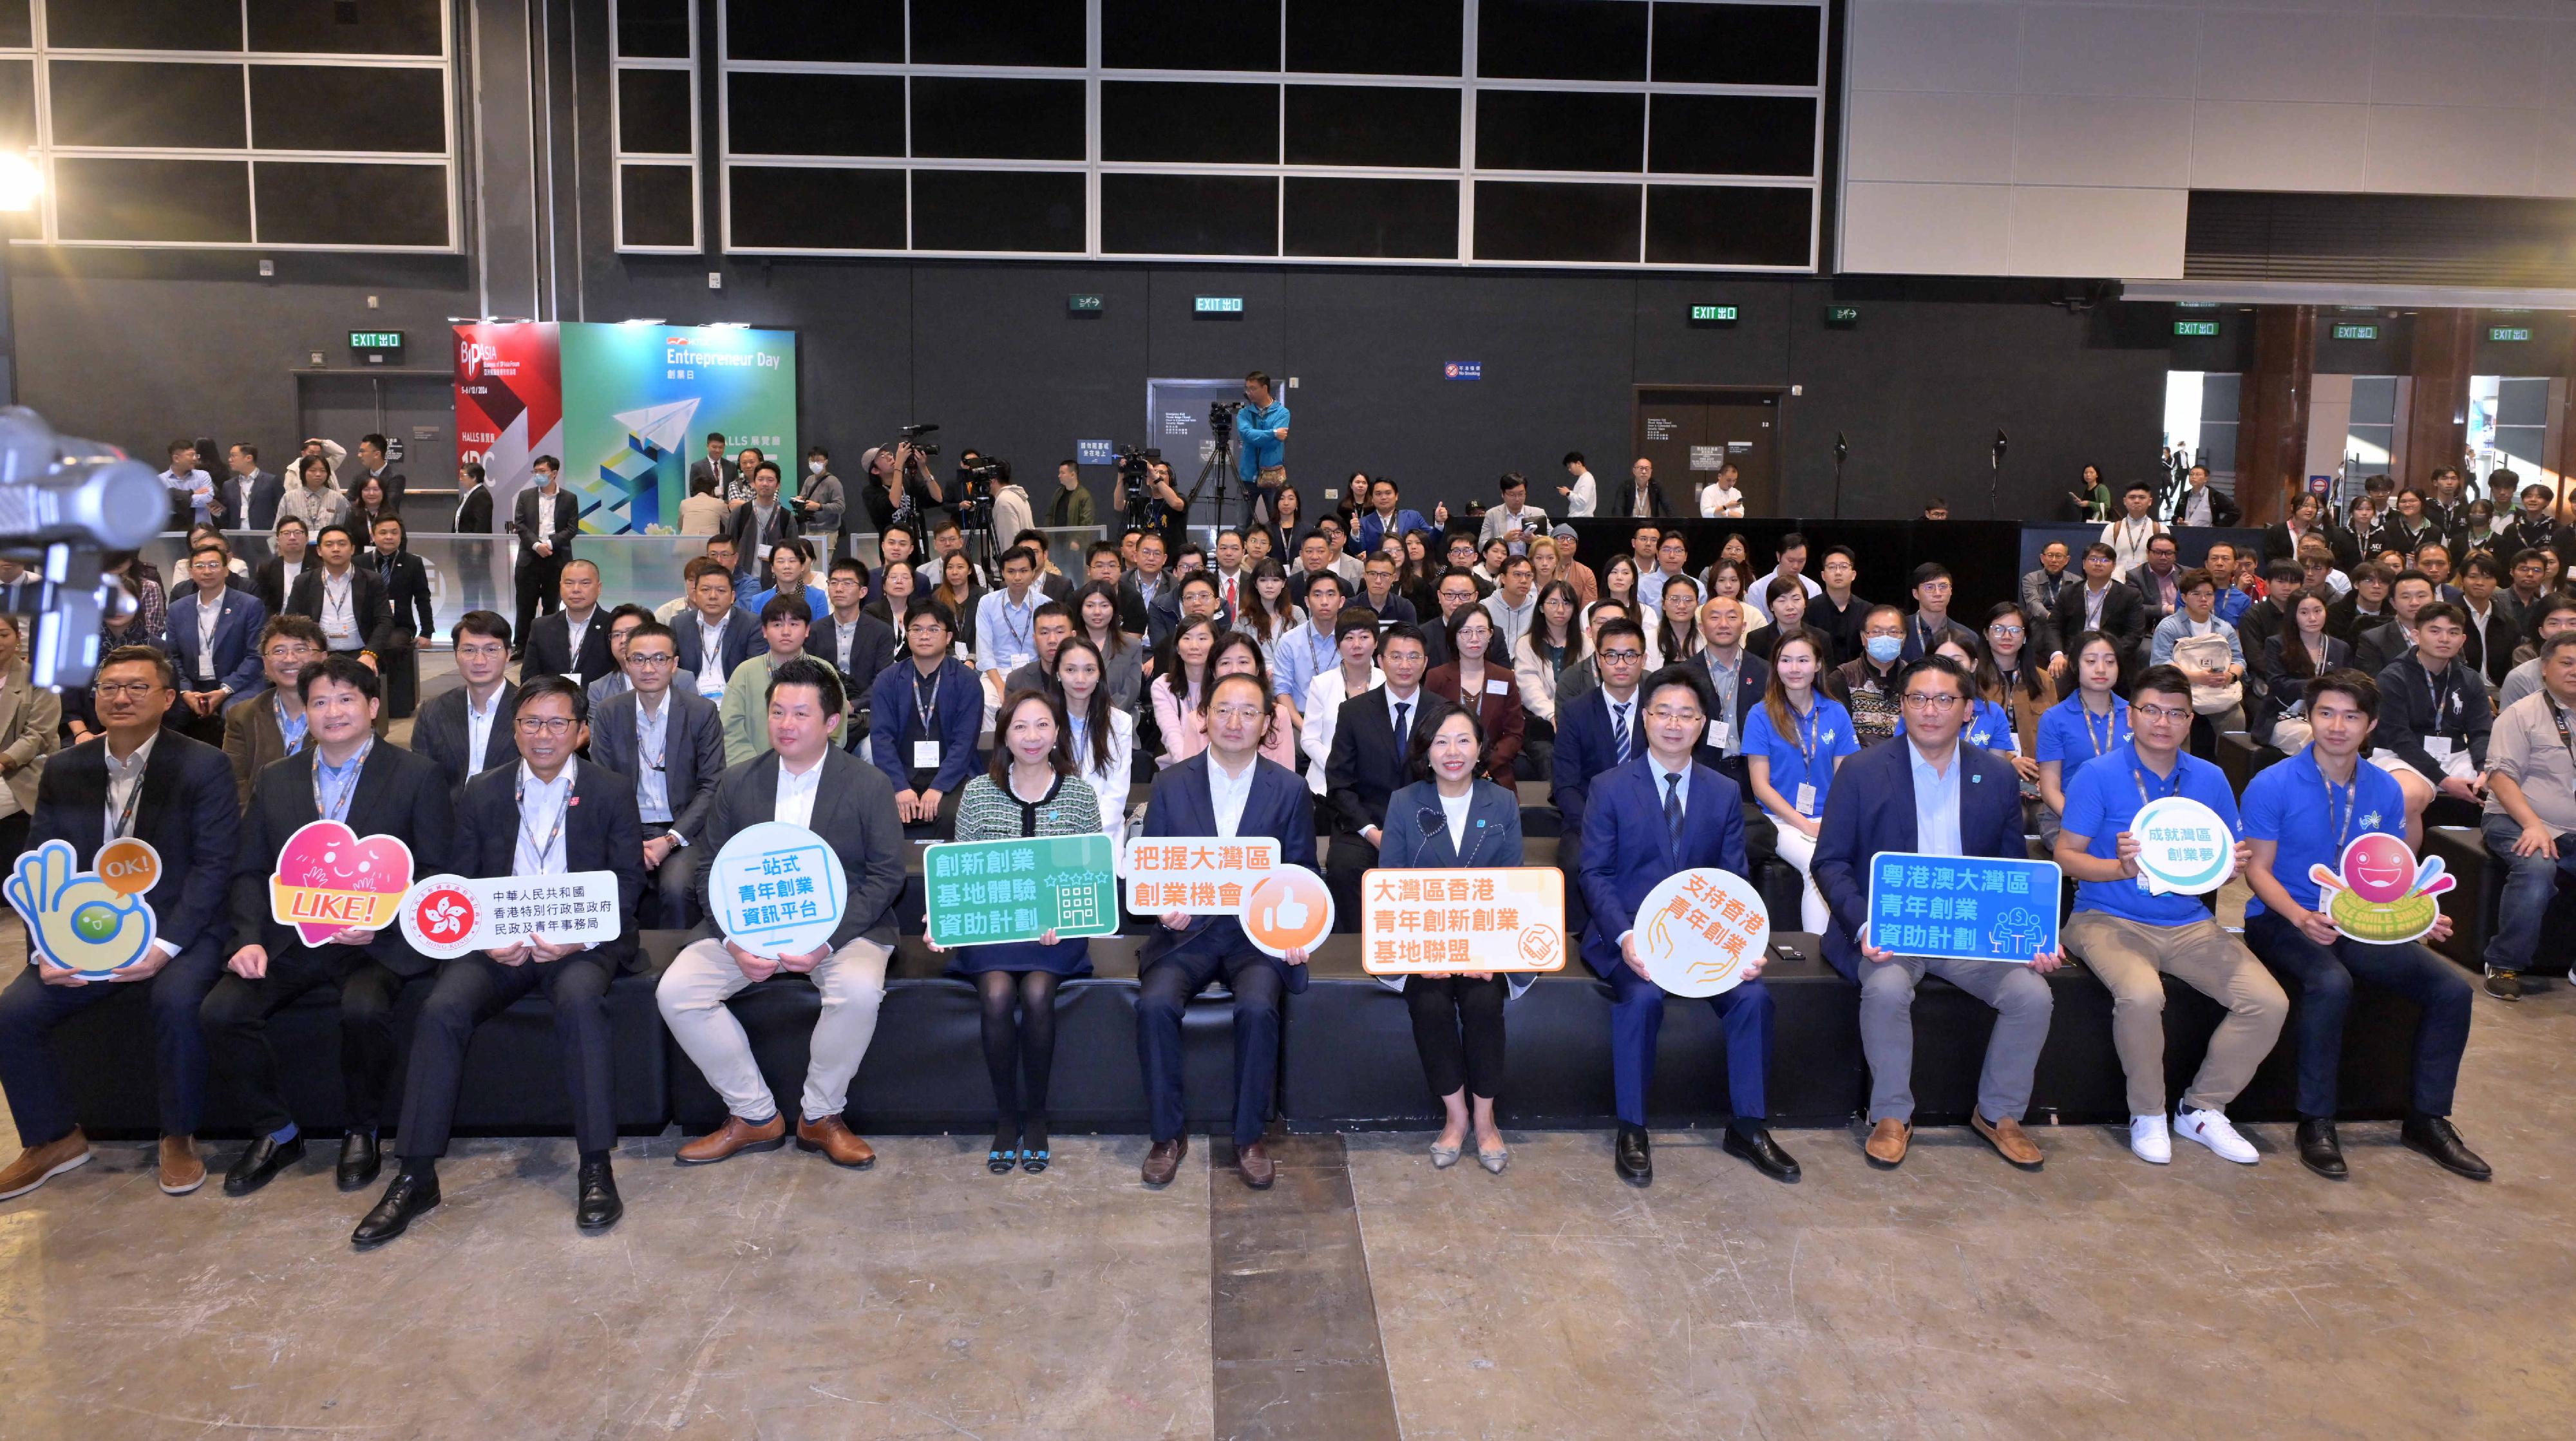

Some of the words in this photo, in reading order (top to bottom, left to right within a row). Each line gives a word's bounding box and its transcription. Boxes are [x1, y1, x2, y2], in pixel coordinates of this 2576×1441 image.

[1198, 298, 1220, 310] EXIT
[1222, 298, 1241, 310] 出口
[1694, 306, 1716, 319] EXIT
[1718, 307, 1736, 319] 出口
[352, 334, 376, 346] EXIT
[379, 334, 399, 346] 出口
[2179, 323, 2198, 334] EXIT
[2199, 323, 2214, 334] 出口
[2338, 327, 2357, 337] EXIT
[2358, 327, 2372, 338] 出口
[2494, 329, 2512, 339] EXIT
[2514, 330, 2528, 340] 出口
[667, 348, 753, 368] Entrepreneur
[757, 352, 780, 370] Day
[667, 370, 694, 379] 創業日
[462, 431, 479, 442] HALLS
[2148, 827, 2211, 843] 成就灣區
[106, 855, 151, 878] OK!
[744, 854, 801, 877] 一站式
[936, 847, 1035, 878] 創新創業
[1134, 845, 1271, 871] 把握大灣區
[2167, 847, 2215, 863] 創業夢
[737, 876, 814, 901] 青年創業
[1373, 878, 1495, 902] 大灣區香港
[1880, 863, 2030, 895] 粵港澳大灣區
[493, 886, 585, 902] 中華人民共和國
[937, 877, 1037, 908] 基地體驗
[1134, 881, 1244, 908] 創業機會
[291, 891, 376, 923] LIKE!
[493, 900, 612, 919] 香港特別行政區政府
[742, 899, 817, 927] 資訊平台
[1681, 872, 1765, 937] 支持香港
[1879, 894, 1978, 922] 青年創業
[495, 918, 598, 936] 民政及青年事務局
[938, 907, 1038, 937] 資助計劃
[1373, 908, 1520, 933] 青年創新創業
[1667, 894, 1748, 957] 青年創業
[2355, 911, 2393, 923] SMILE
[426, 940, 447, 949] HONG
[450, 937, 469, 948] KONG
[1879, 923, 1977, 951] 資助計劃
[1374, 939, 1471, 964] 基地聯盟
